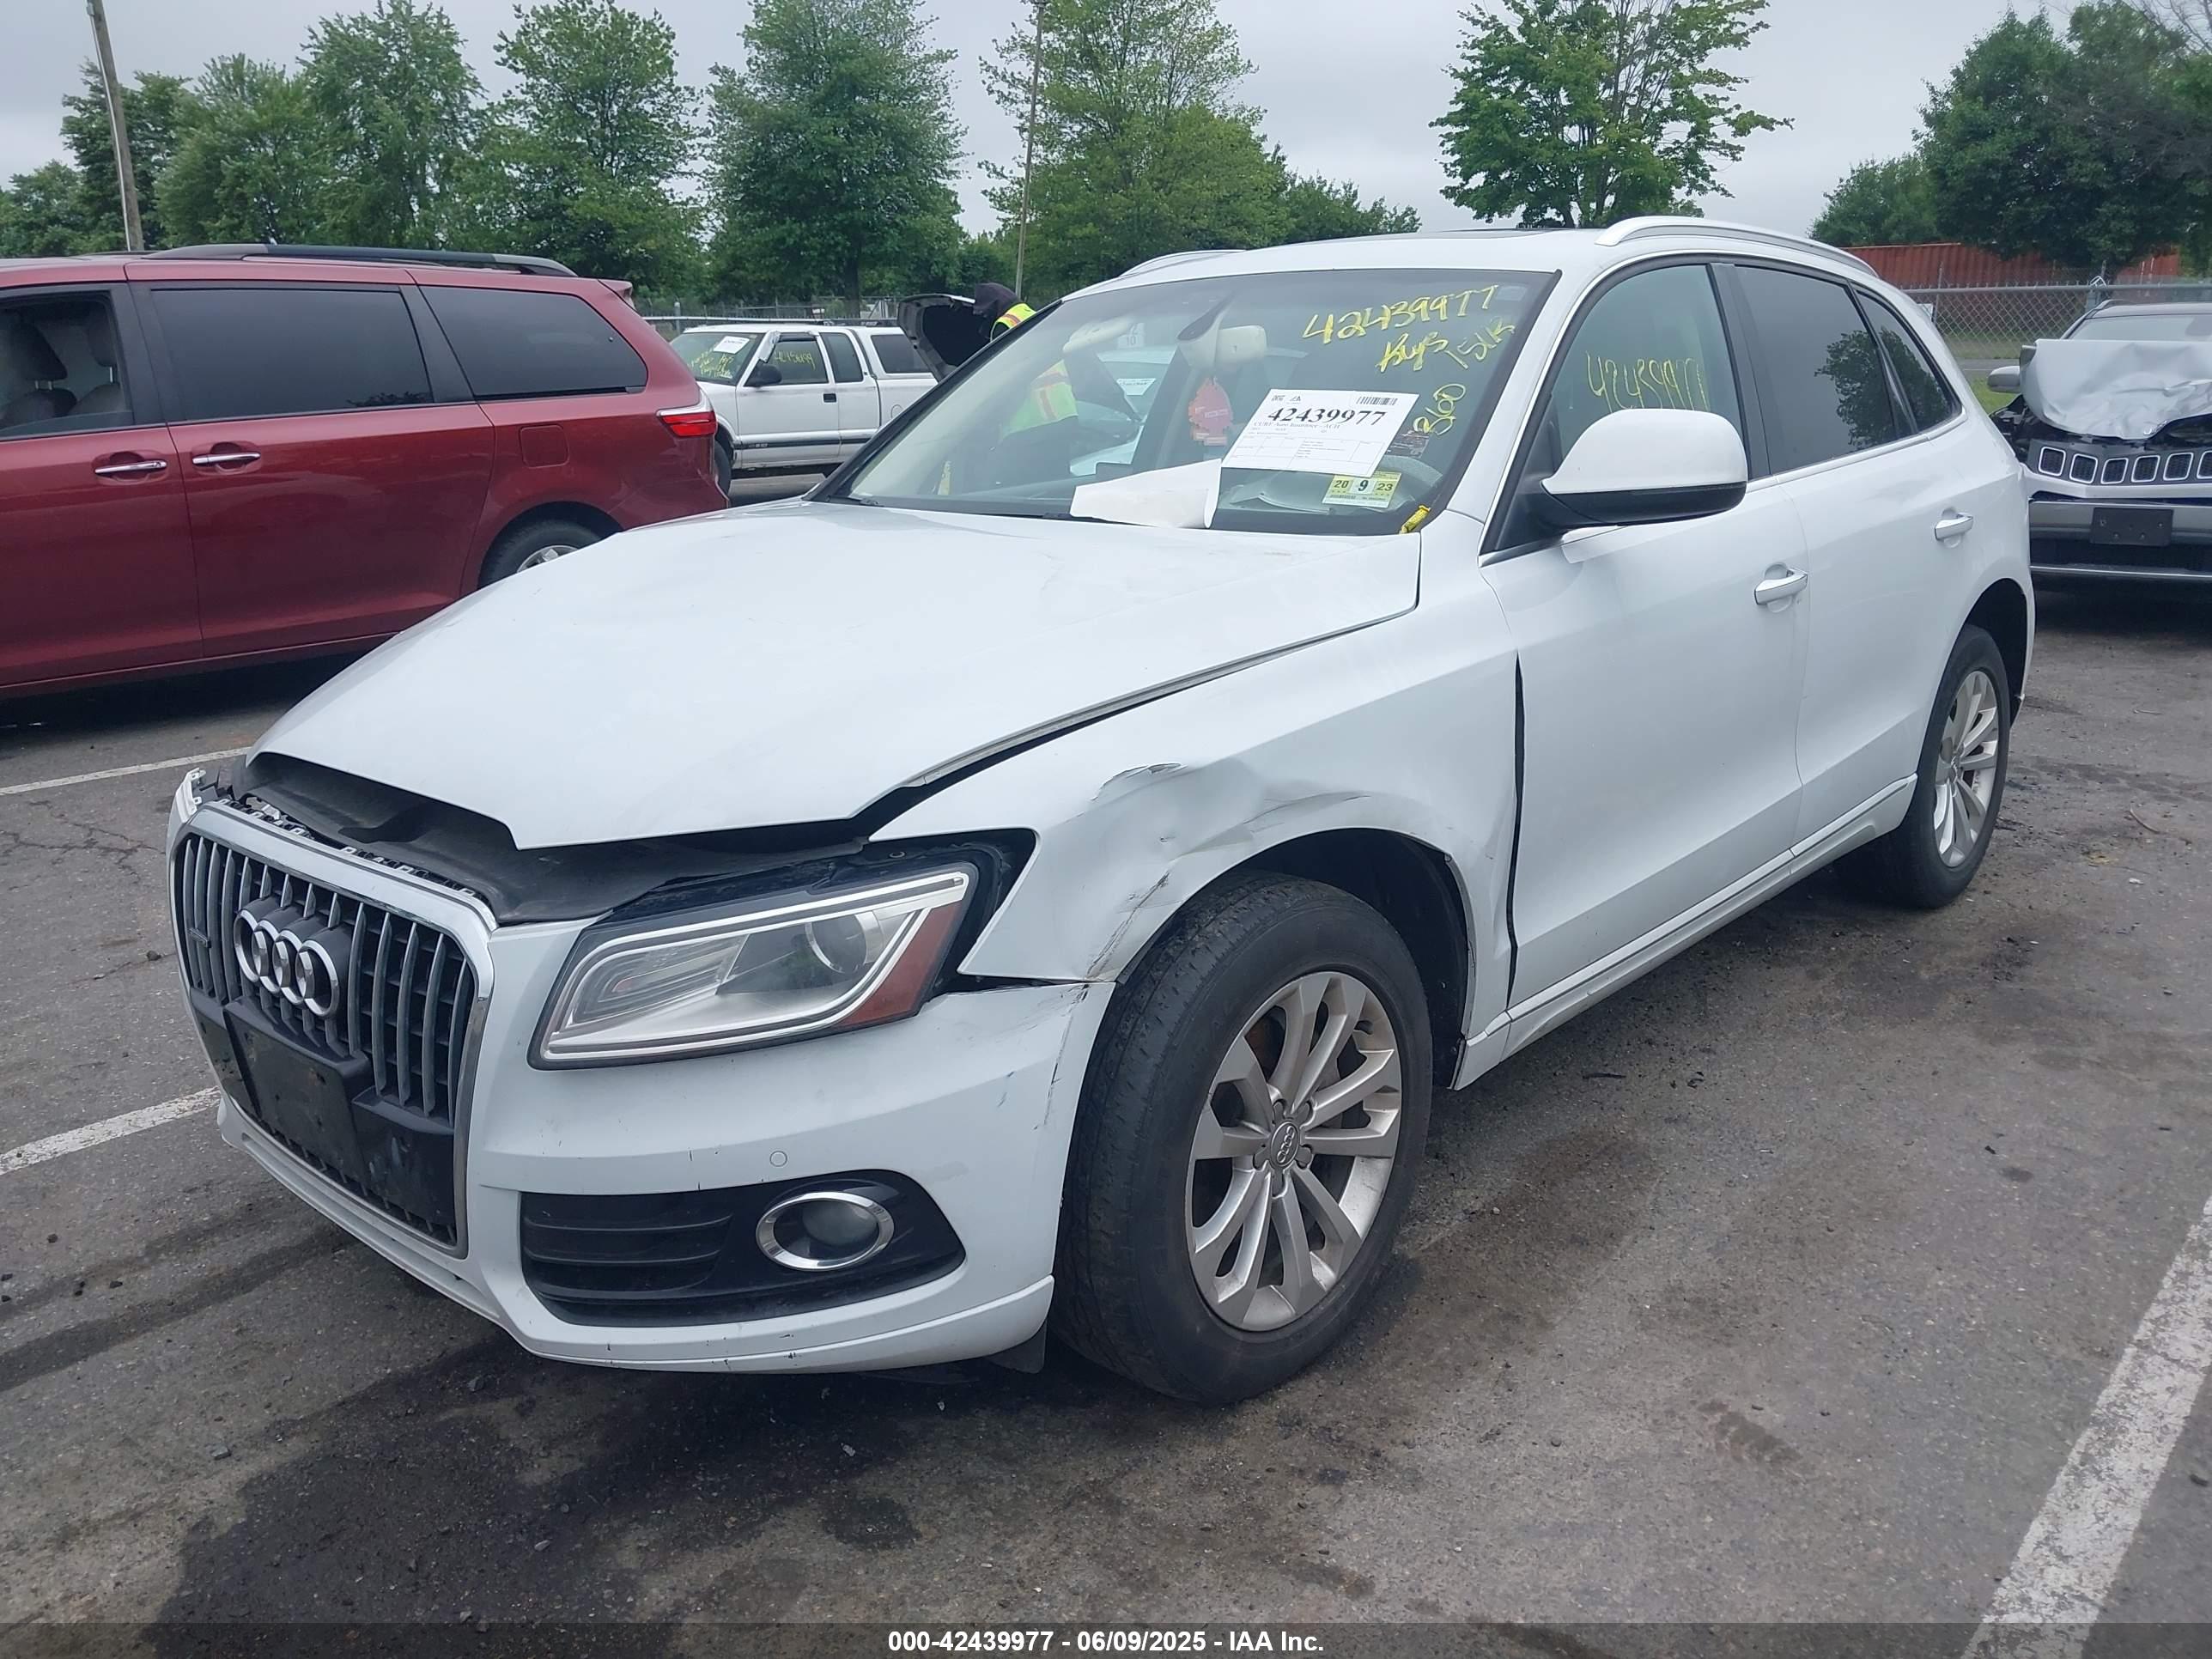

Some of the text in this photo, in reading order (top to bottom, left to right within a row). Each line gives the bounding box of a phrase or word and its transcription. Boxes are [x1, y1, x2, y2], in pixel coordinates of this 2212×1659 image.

[1302, 284, 1499, 344] 42439977
[1267, 407, 1389, 426] 42439977
[1334, 479, 1394, 492] 20 9 23
